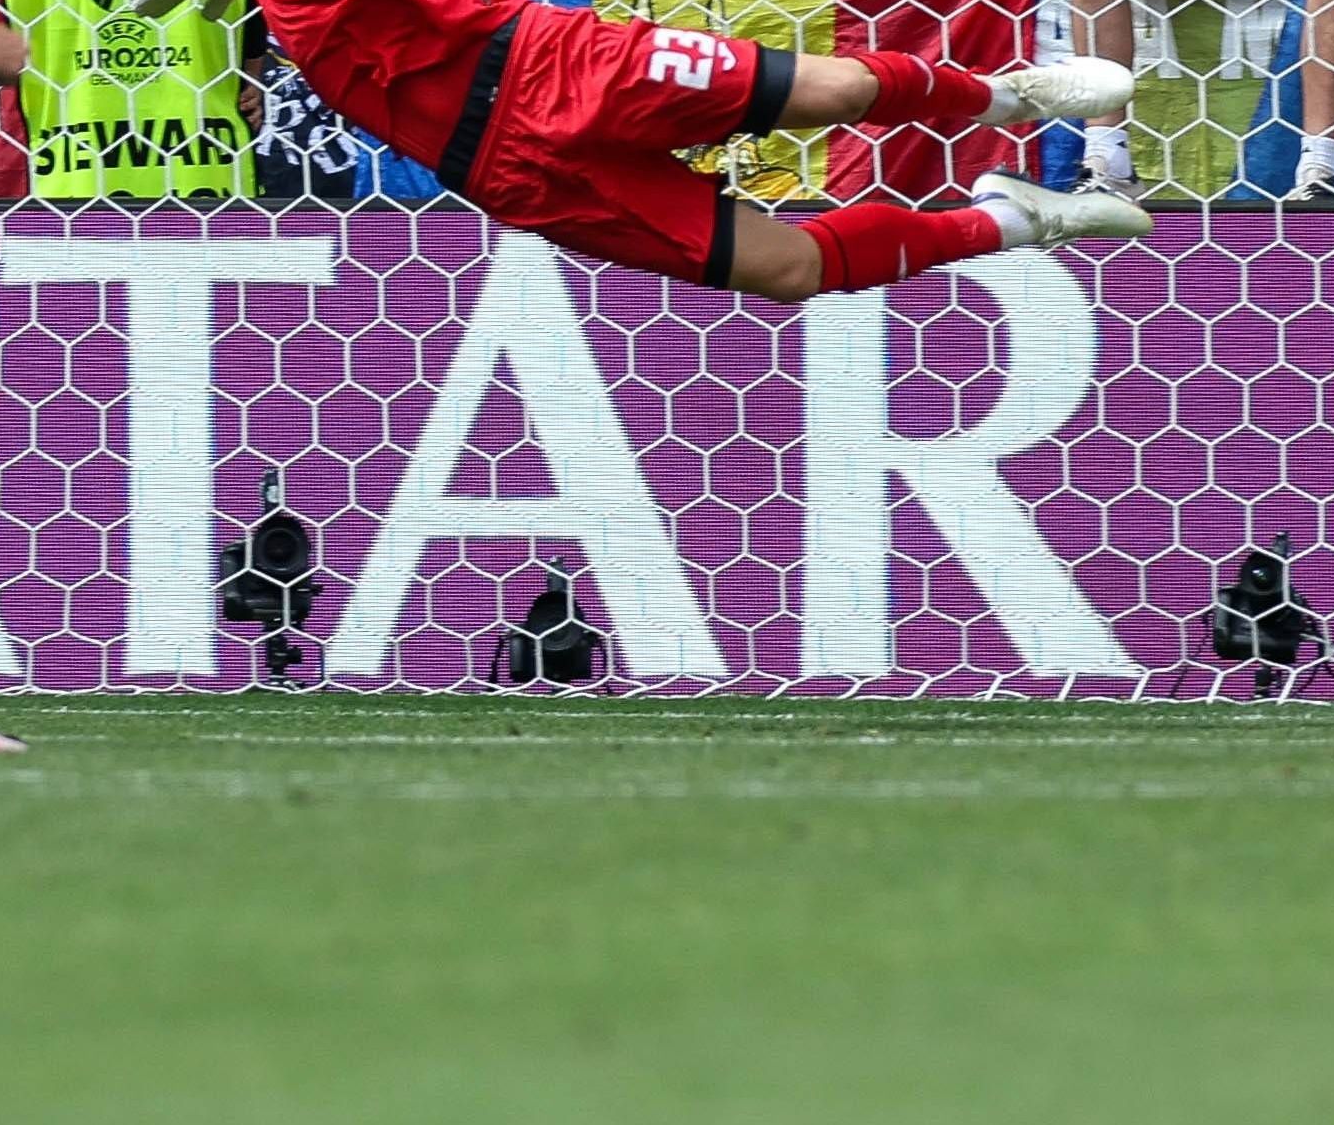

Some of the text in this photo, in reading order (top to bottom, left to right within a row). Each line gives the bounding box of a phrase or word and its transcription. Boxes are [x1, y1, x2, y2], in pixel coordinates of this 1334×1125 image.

[99, 24, 146, 43] UEFA
[74, 46, 193, 70] EURO2024
[647, 27, 715, 91] 23
[90, 72, 163, 86] GERMANY
[34, 117, 238, 176] STEWARD
